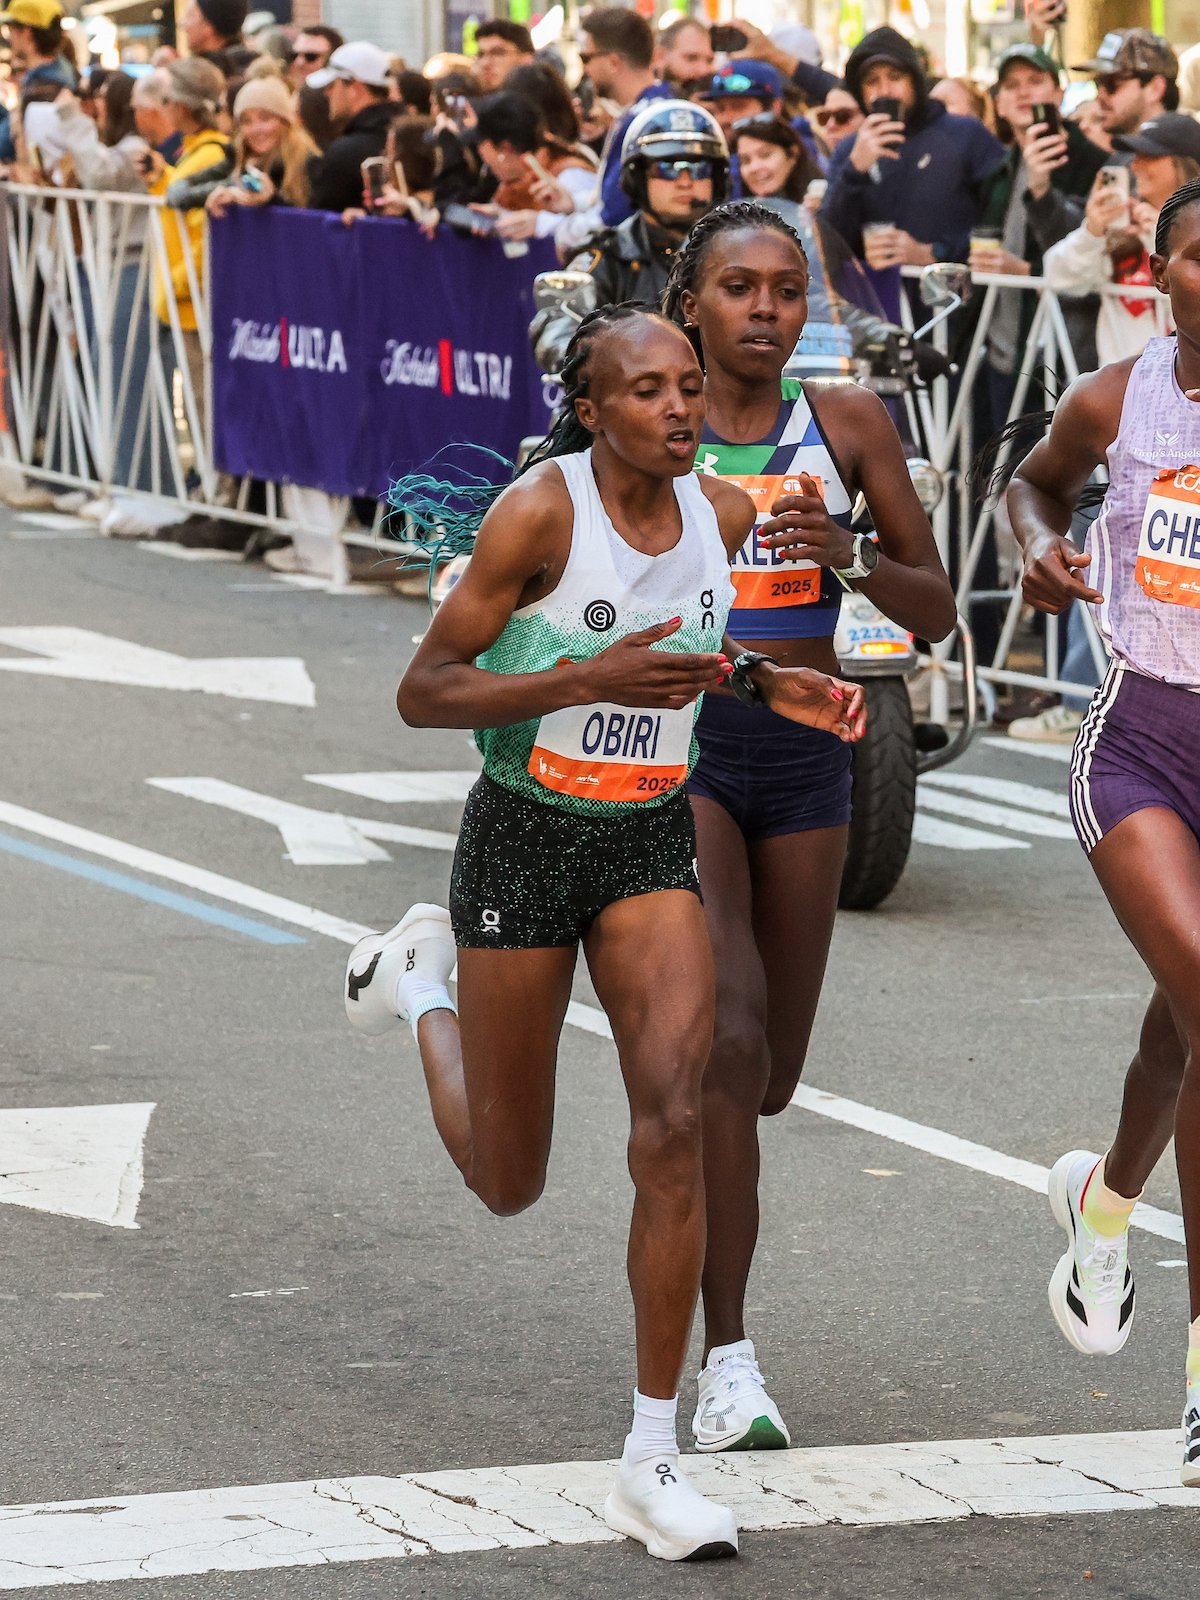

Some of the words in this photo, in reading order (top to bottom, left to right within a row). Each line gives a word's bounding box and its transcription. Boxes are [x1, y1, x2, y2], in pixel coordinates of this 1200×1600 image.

[771, 579, 812, 597] 2025
[581, 711, 662, 760] OBIRI
[636, 776, 679, 791] 2025
